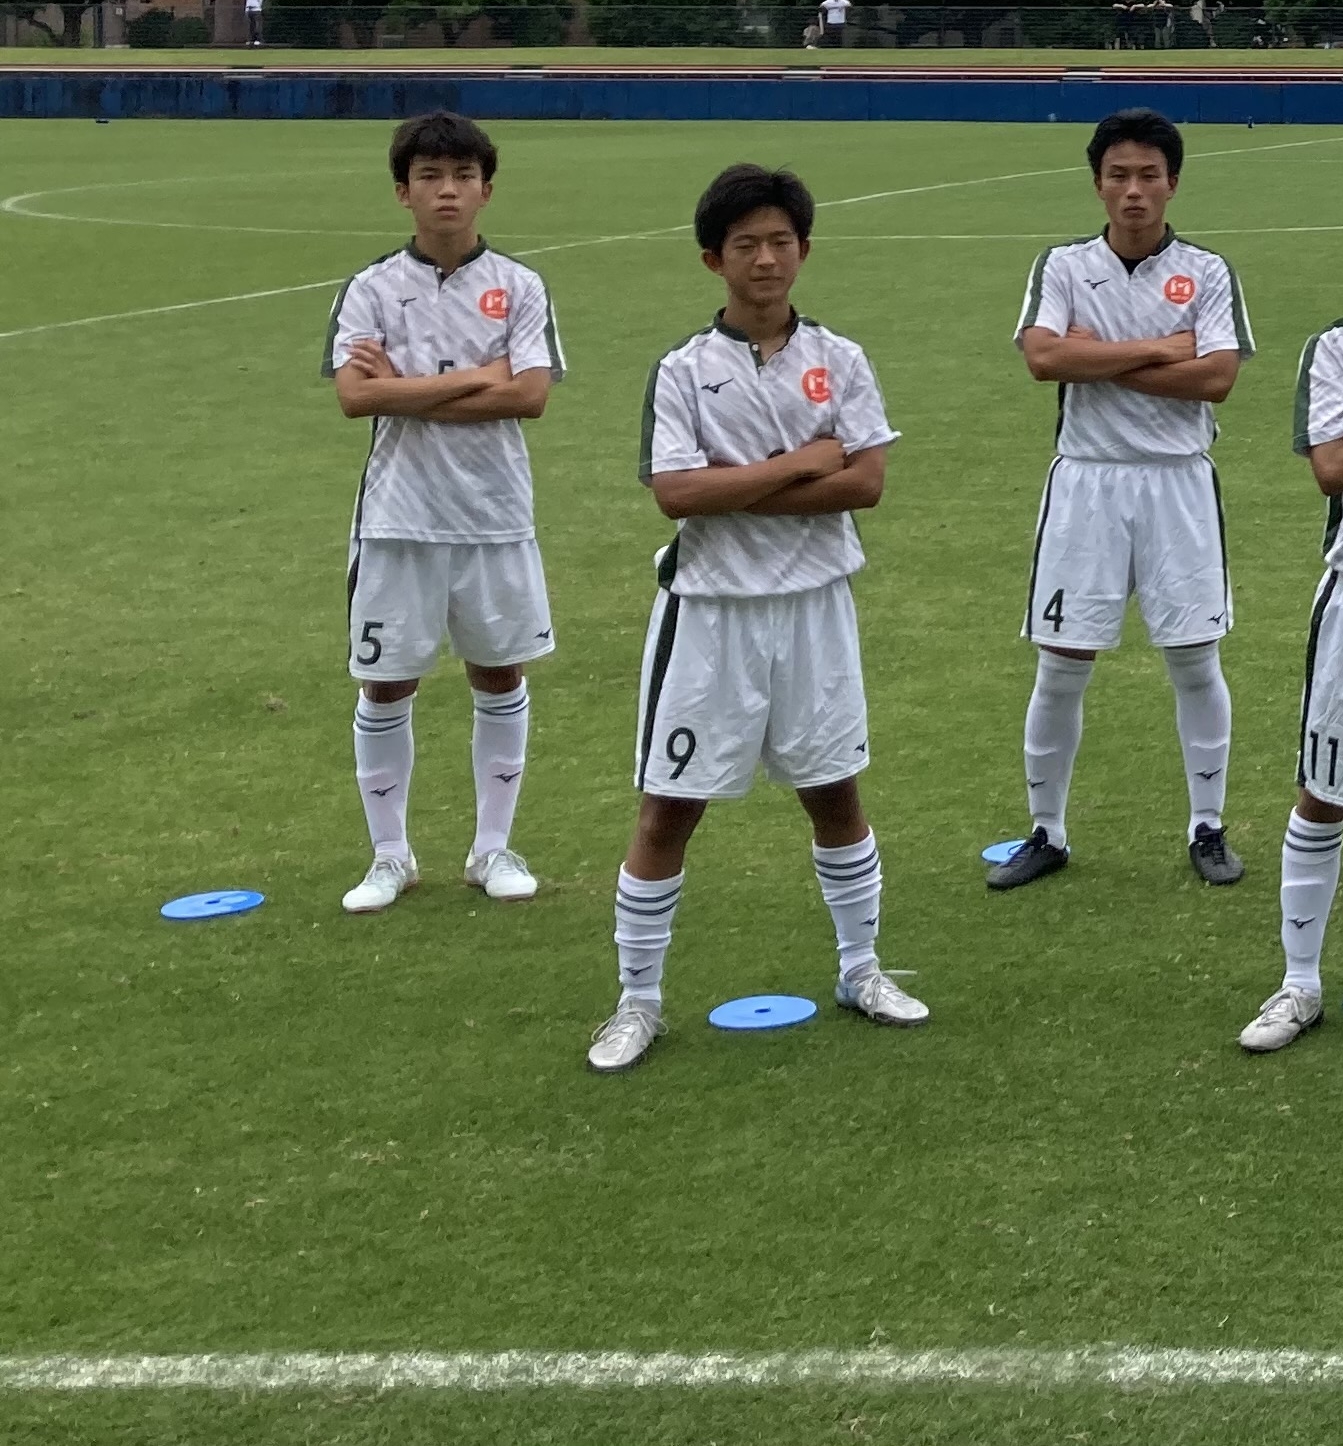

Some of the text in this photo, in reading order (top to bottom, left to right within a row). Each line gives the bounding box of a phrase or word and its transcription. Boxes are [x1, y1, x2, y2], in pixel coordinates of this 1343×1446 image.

[1042, 588, 1064, 632] 4
[357, 621, 384, 665] 5
[666, 727, 696, 780] 9
[1310, 730, 1339, 786] 11
